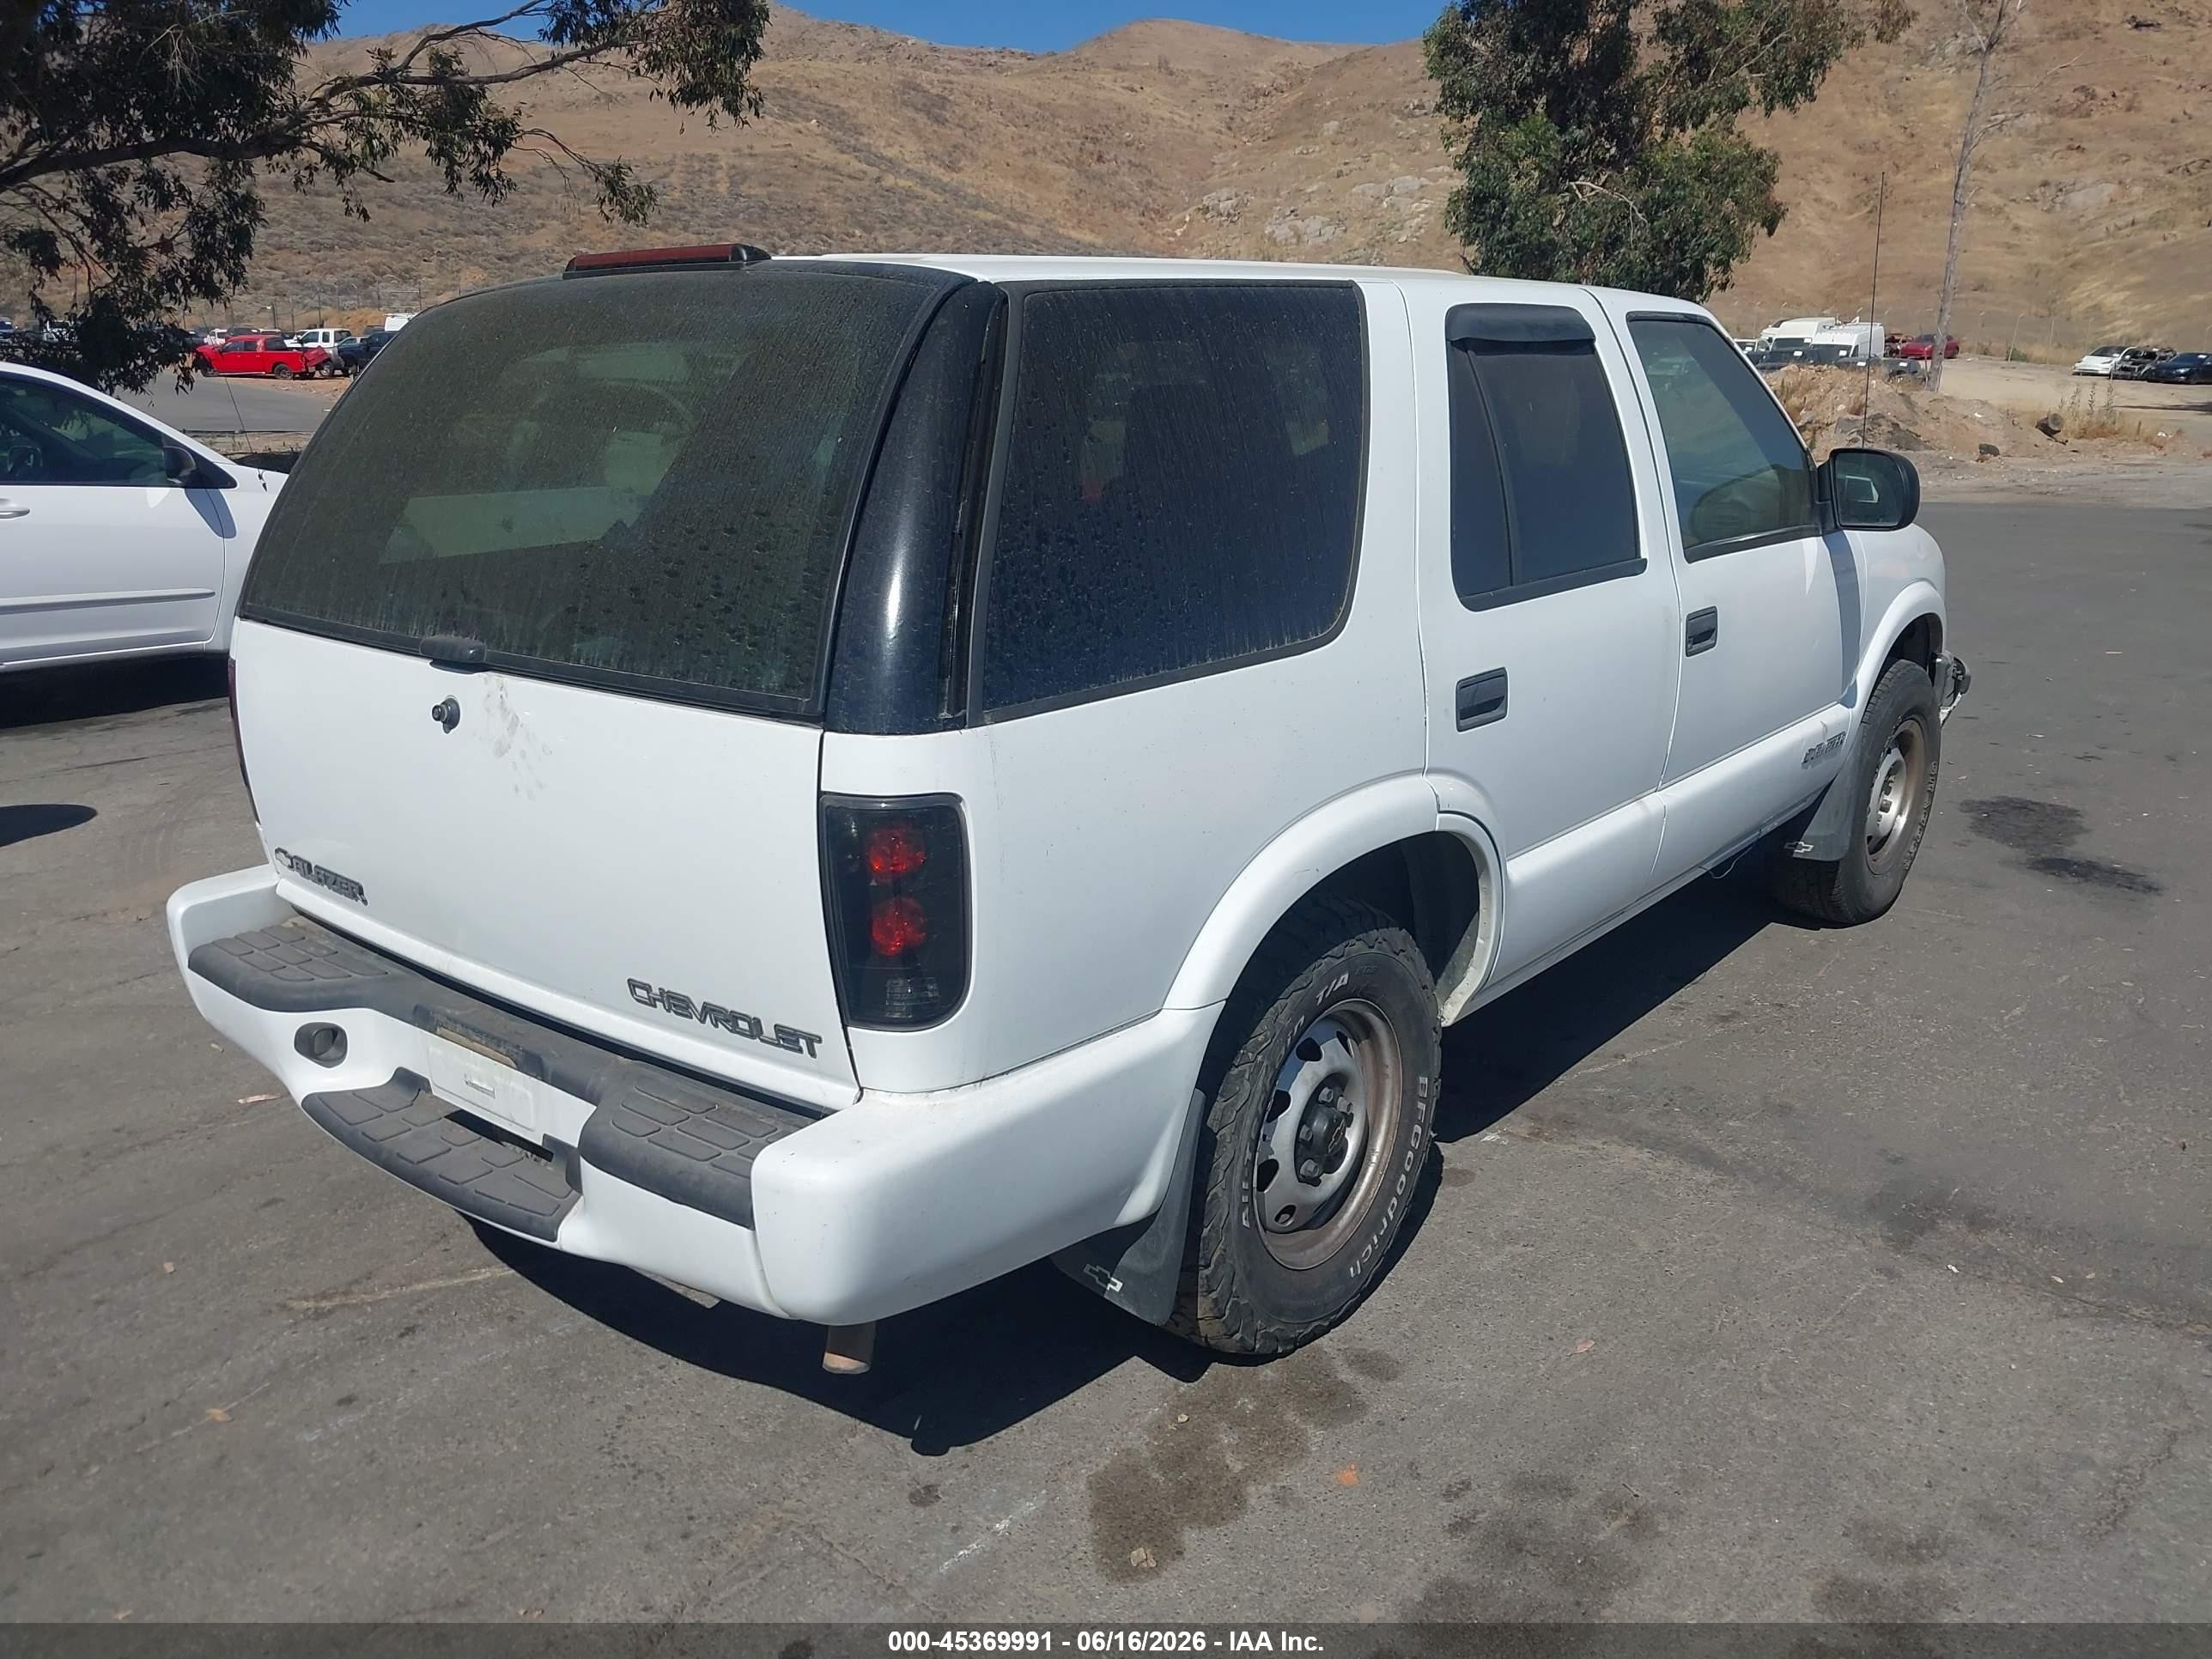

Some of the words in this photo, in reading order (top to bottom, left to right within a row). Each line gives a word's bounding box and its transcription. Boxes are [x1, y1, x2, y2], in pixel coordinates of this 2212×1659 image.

[627, 977, 823, 1059] CHEVROLET
[1316, 972, 1350, 1006] T/A
[1349, 1076, 1429, 1278] BFGoodrich
